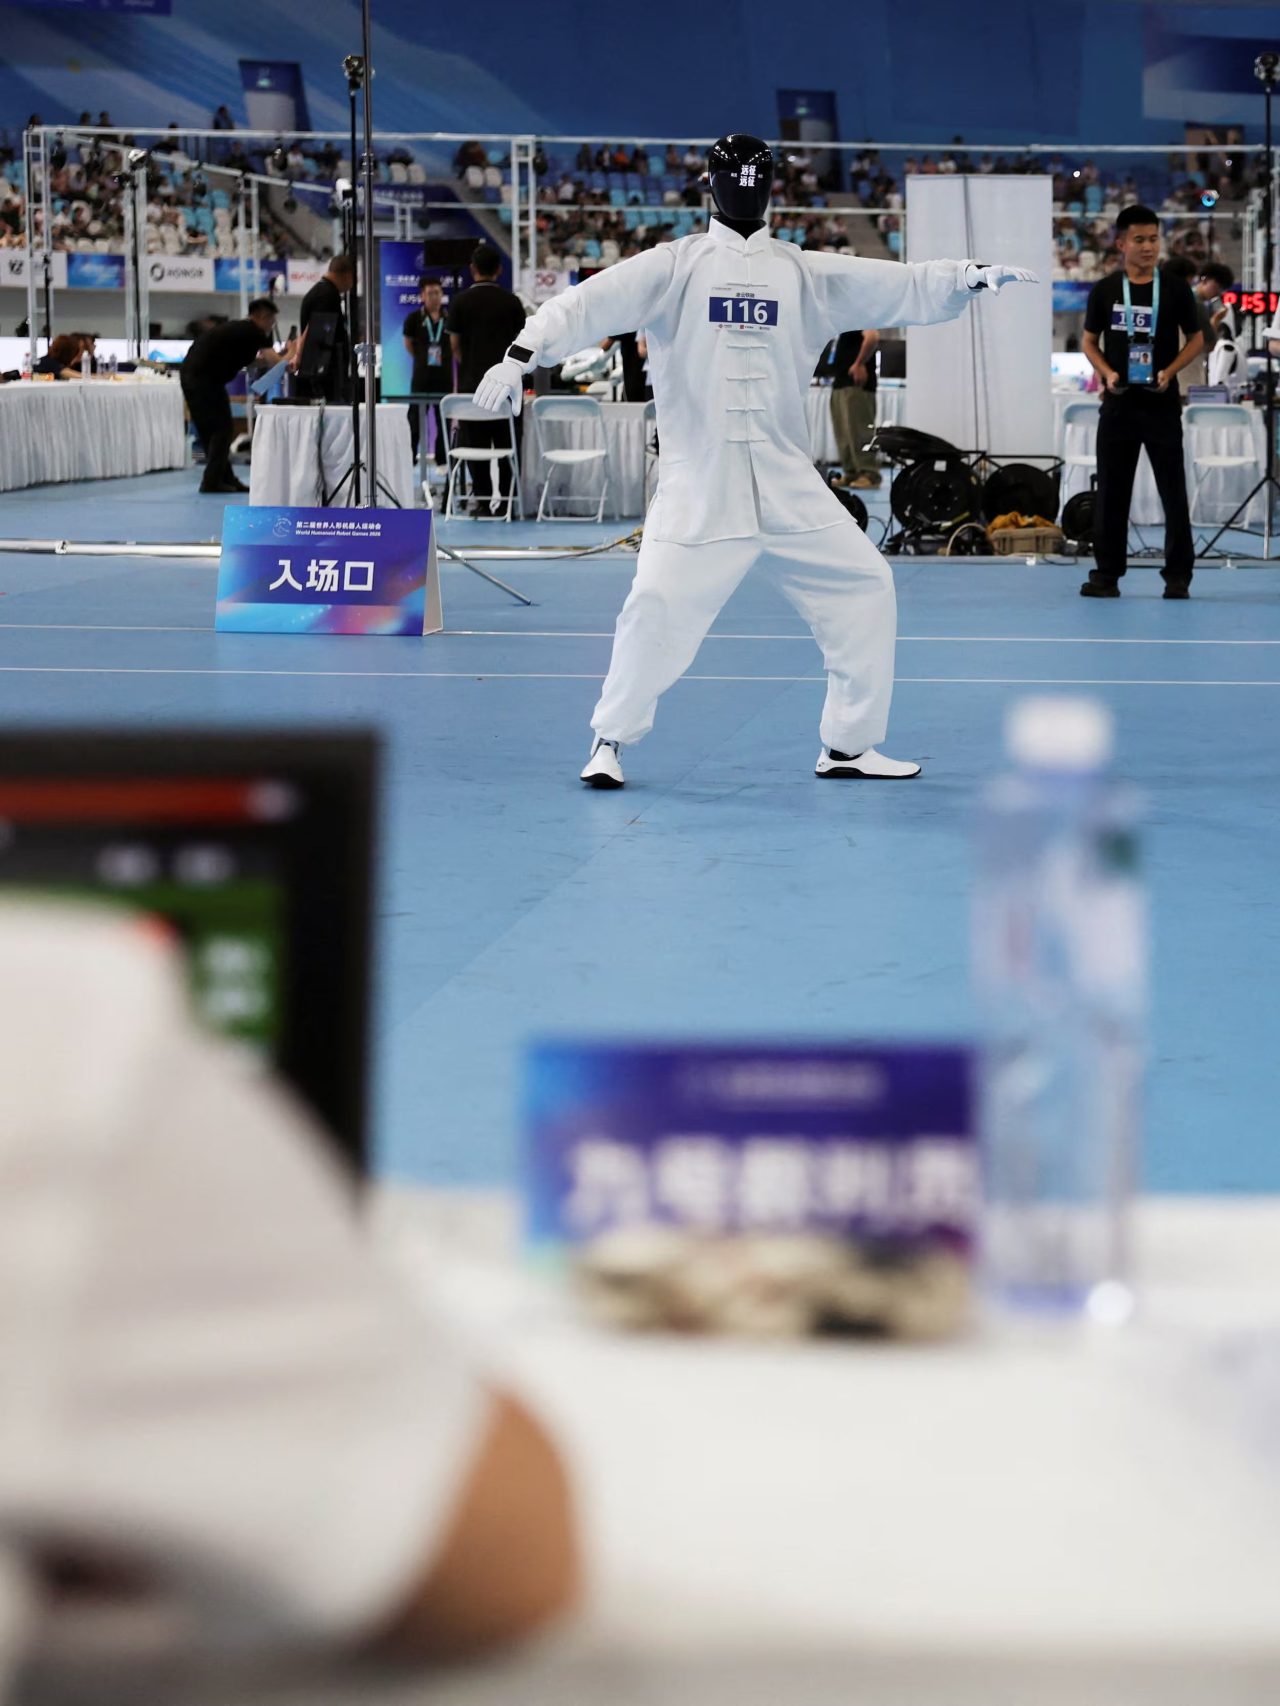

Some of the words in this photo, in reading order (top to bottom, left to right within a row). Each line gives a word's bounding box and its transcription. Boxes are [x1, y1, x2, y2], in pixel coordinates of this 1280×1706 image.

[722, 299, 768, 324] 116
[296, 521, 381, 530] 第二届世界人形机器人运动会
[269, 559, 374, 592] 入场口
